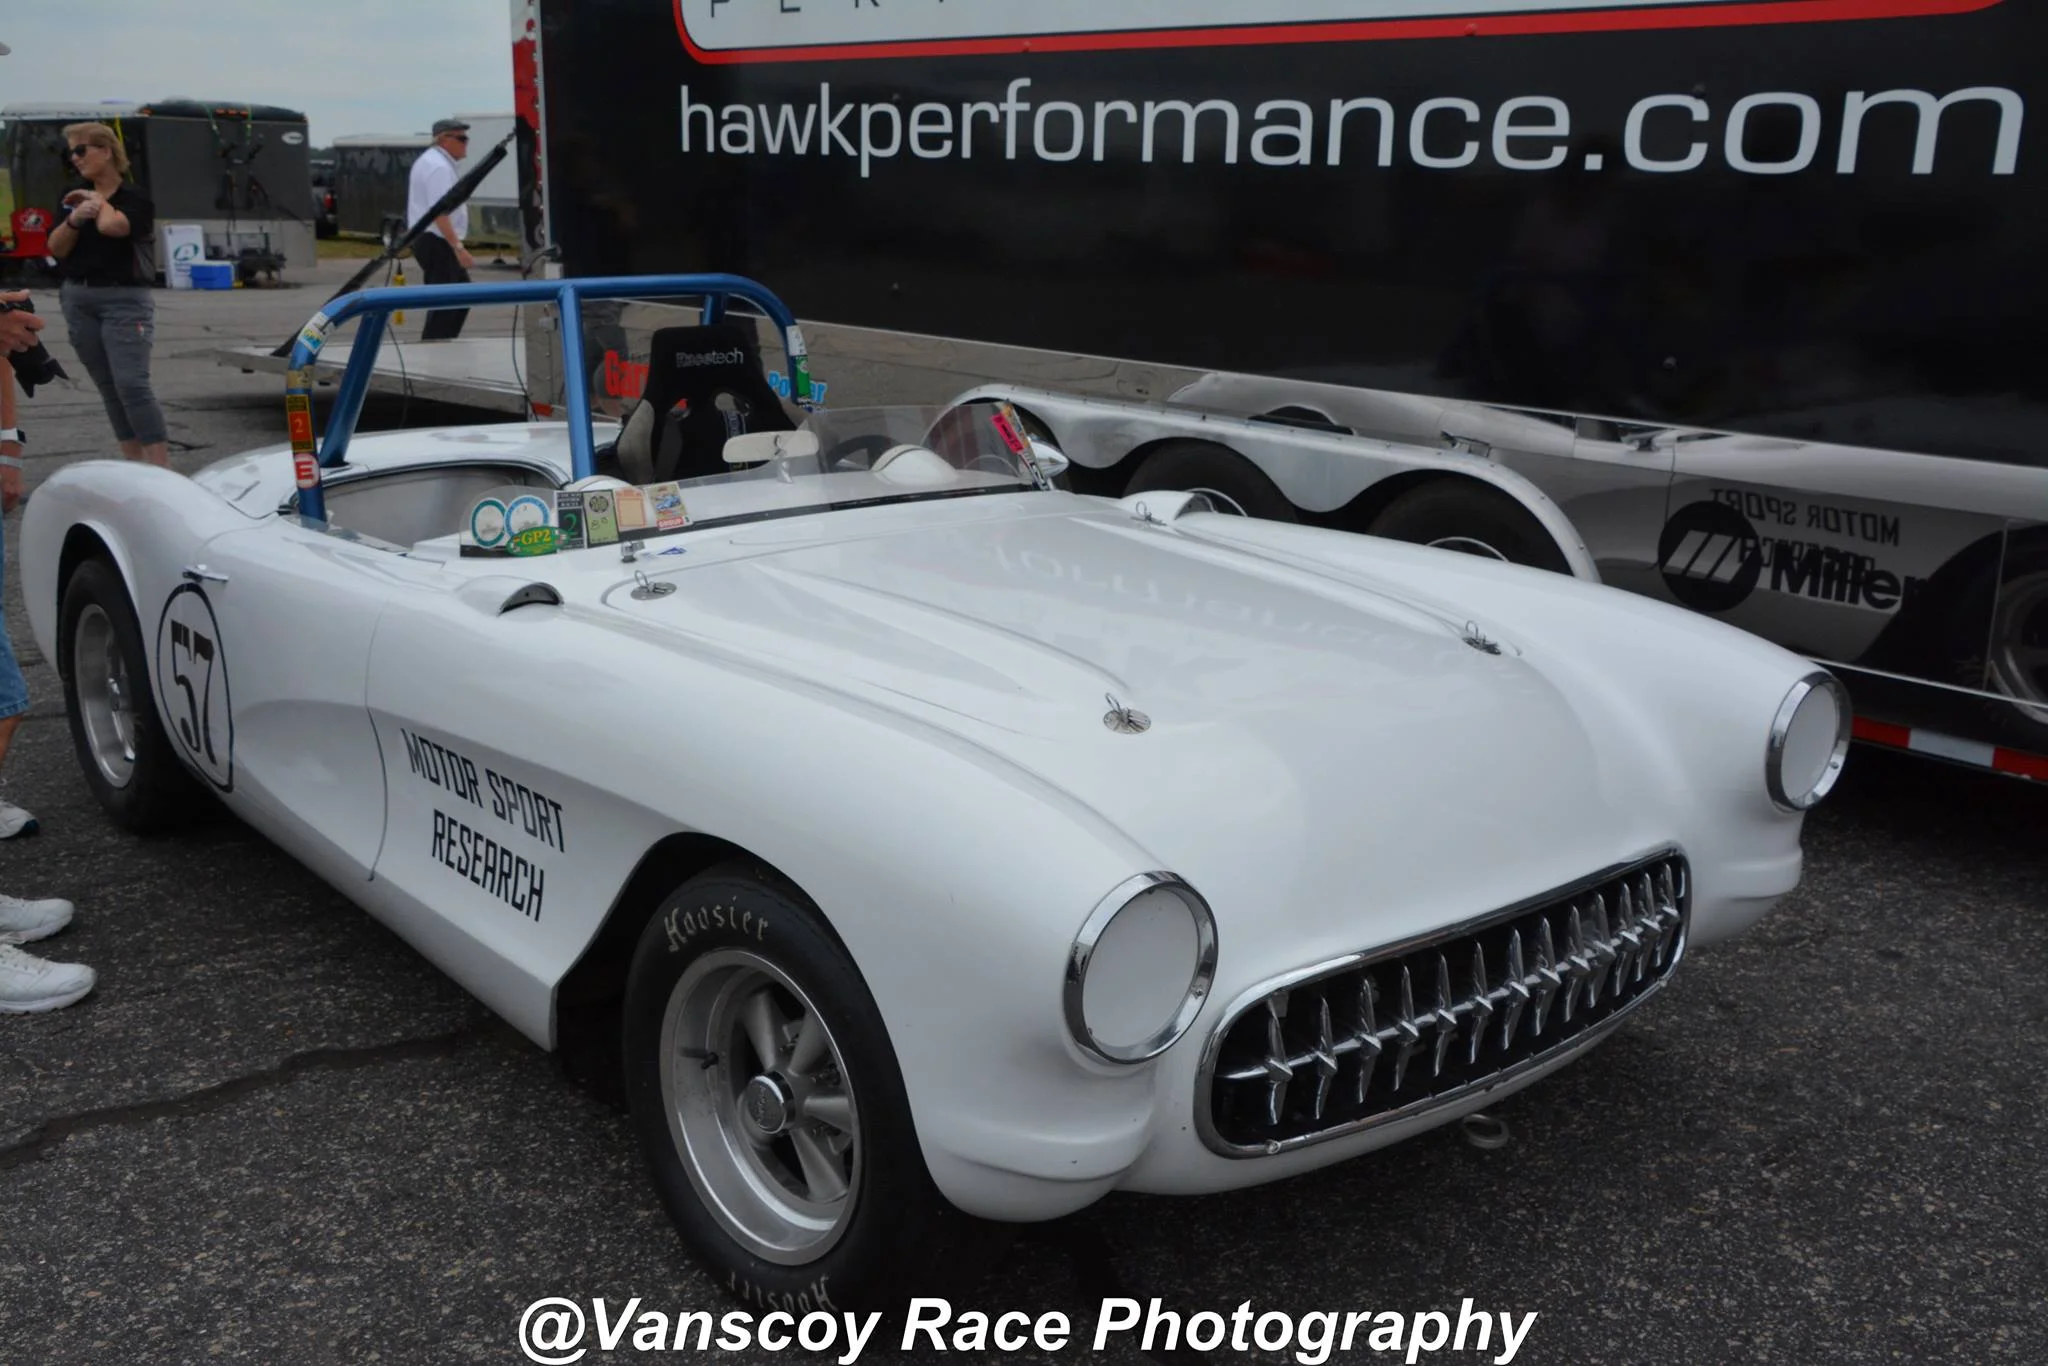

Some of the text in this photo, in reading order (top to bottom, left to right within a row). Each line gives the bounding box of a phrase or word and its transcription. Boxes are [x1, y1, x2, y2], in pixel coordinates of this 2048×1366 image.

[680, 77, 2024, 178] hawkperformance.com
[296, 461, 314, 481] E
[520, 528, 552, 546] GP2
[171, 618, 218, 766] 57
[401, 728, 566, 853] MOTOR SPORT
[432, 808, 546, 923] RESEARCH
[664, 904, 770, 953] Hoosier
